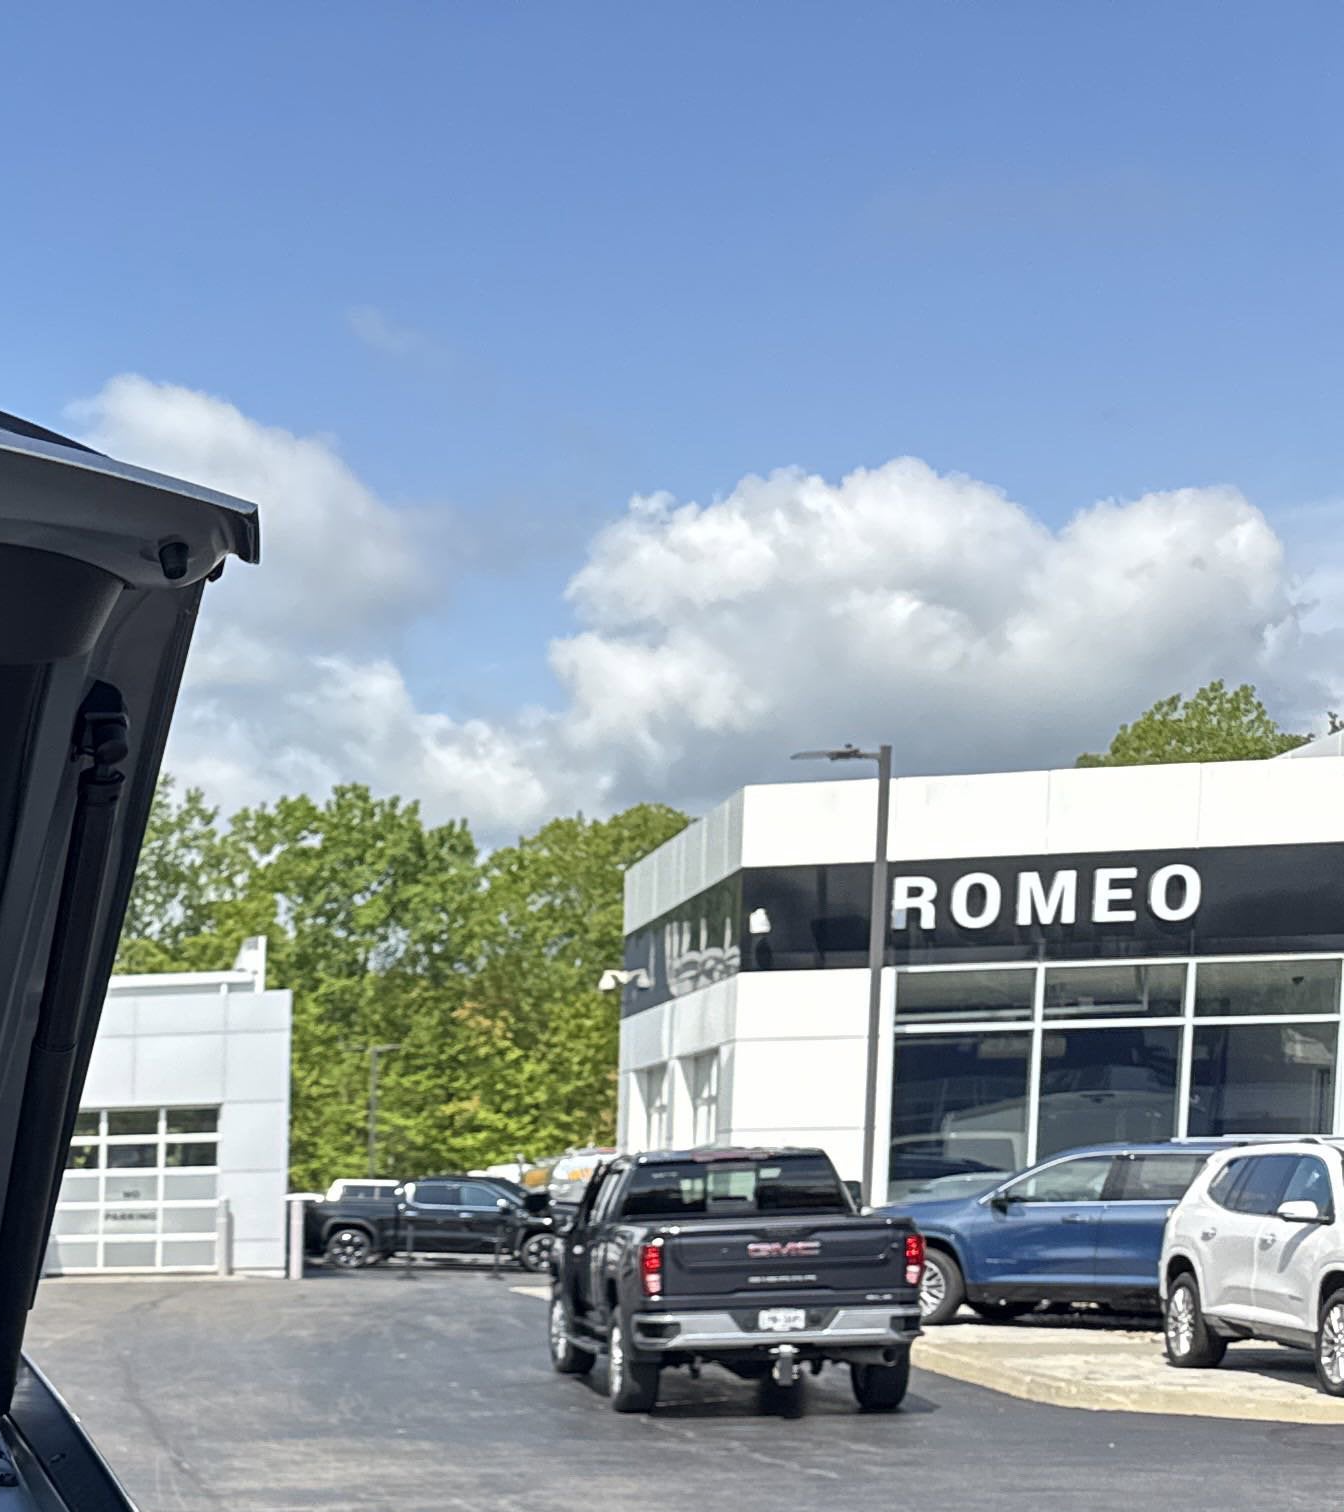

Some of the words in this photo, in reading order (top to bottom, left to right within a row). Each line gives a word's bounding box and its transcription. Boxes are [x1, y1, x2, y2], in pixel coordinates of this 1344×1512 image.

[891, 864, 1202, 930] ROMEO
[104, 1211, 157, 1222] PARKING
[746, 1241, 821, 1258] GMC
